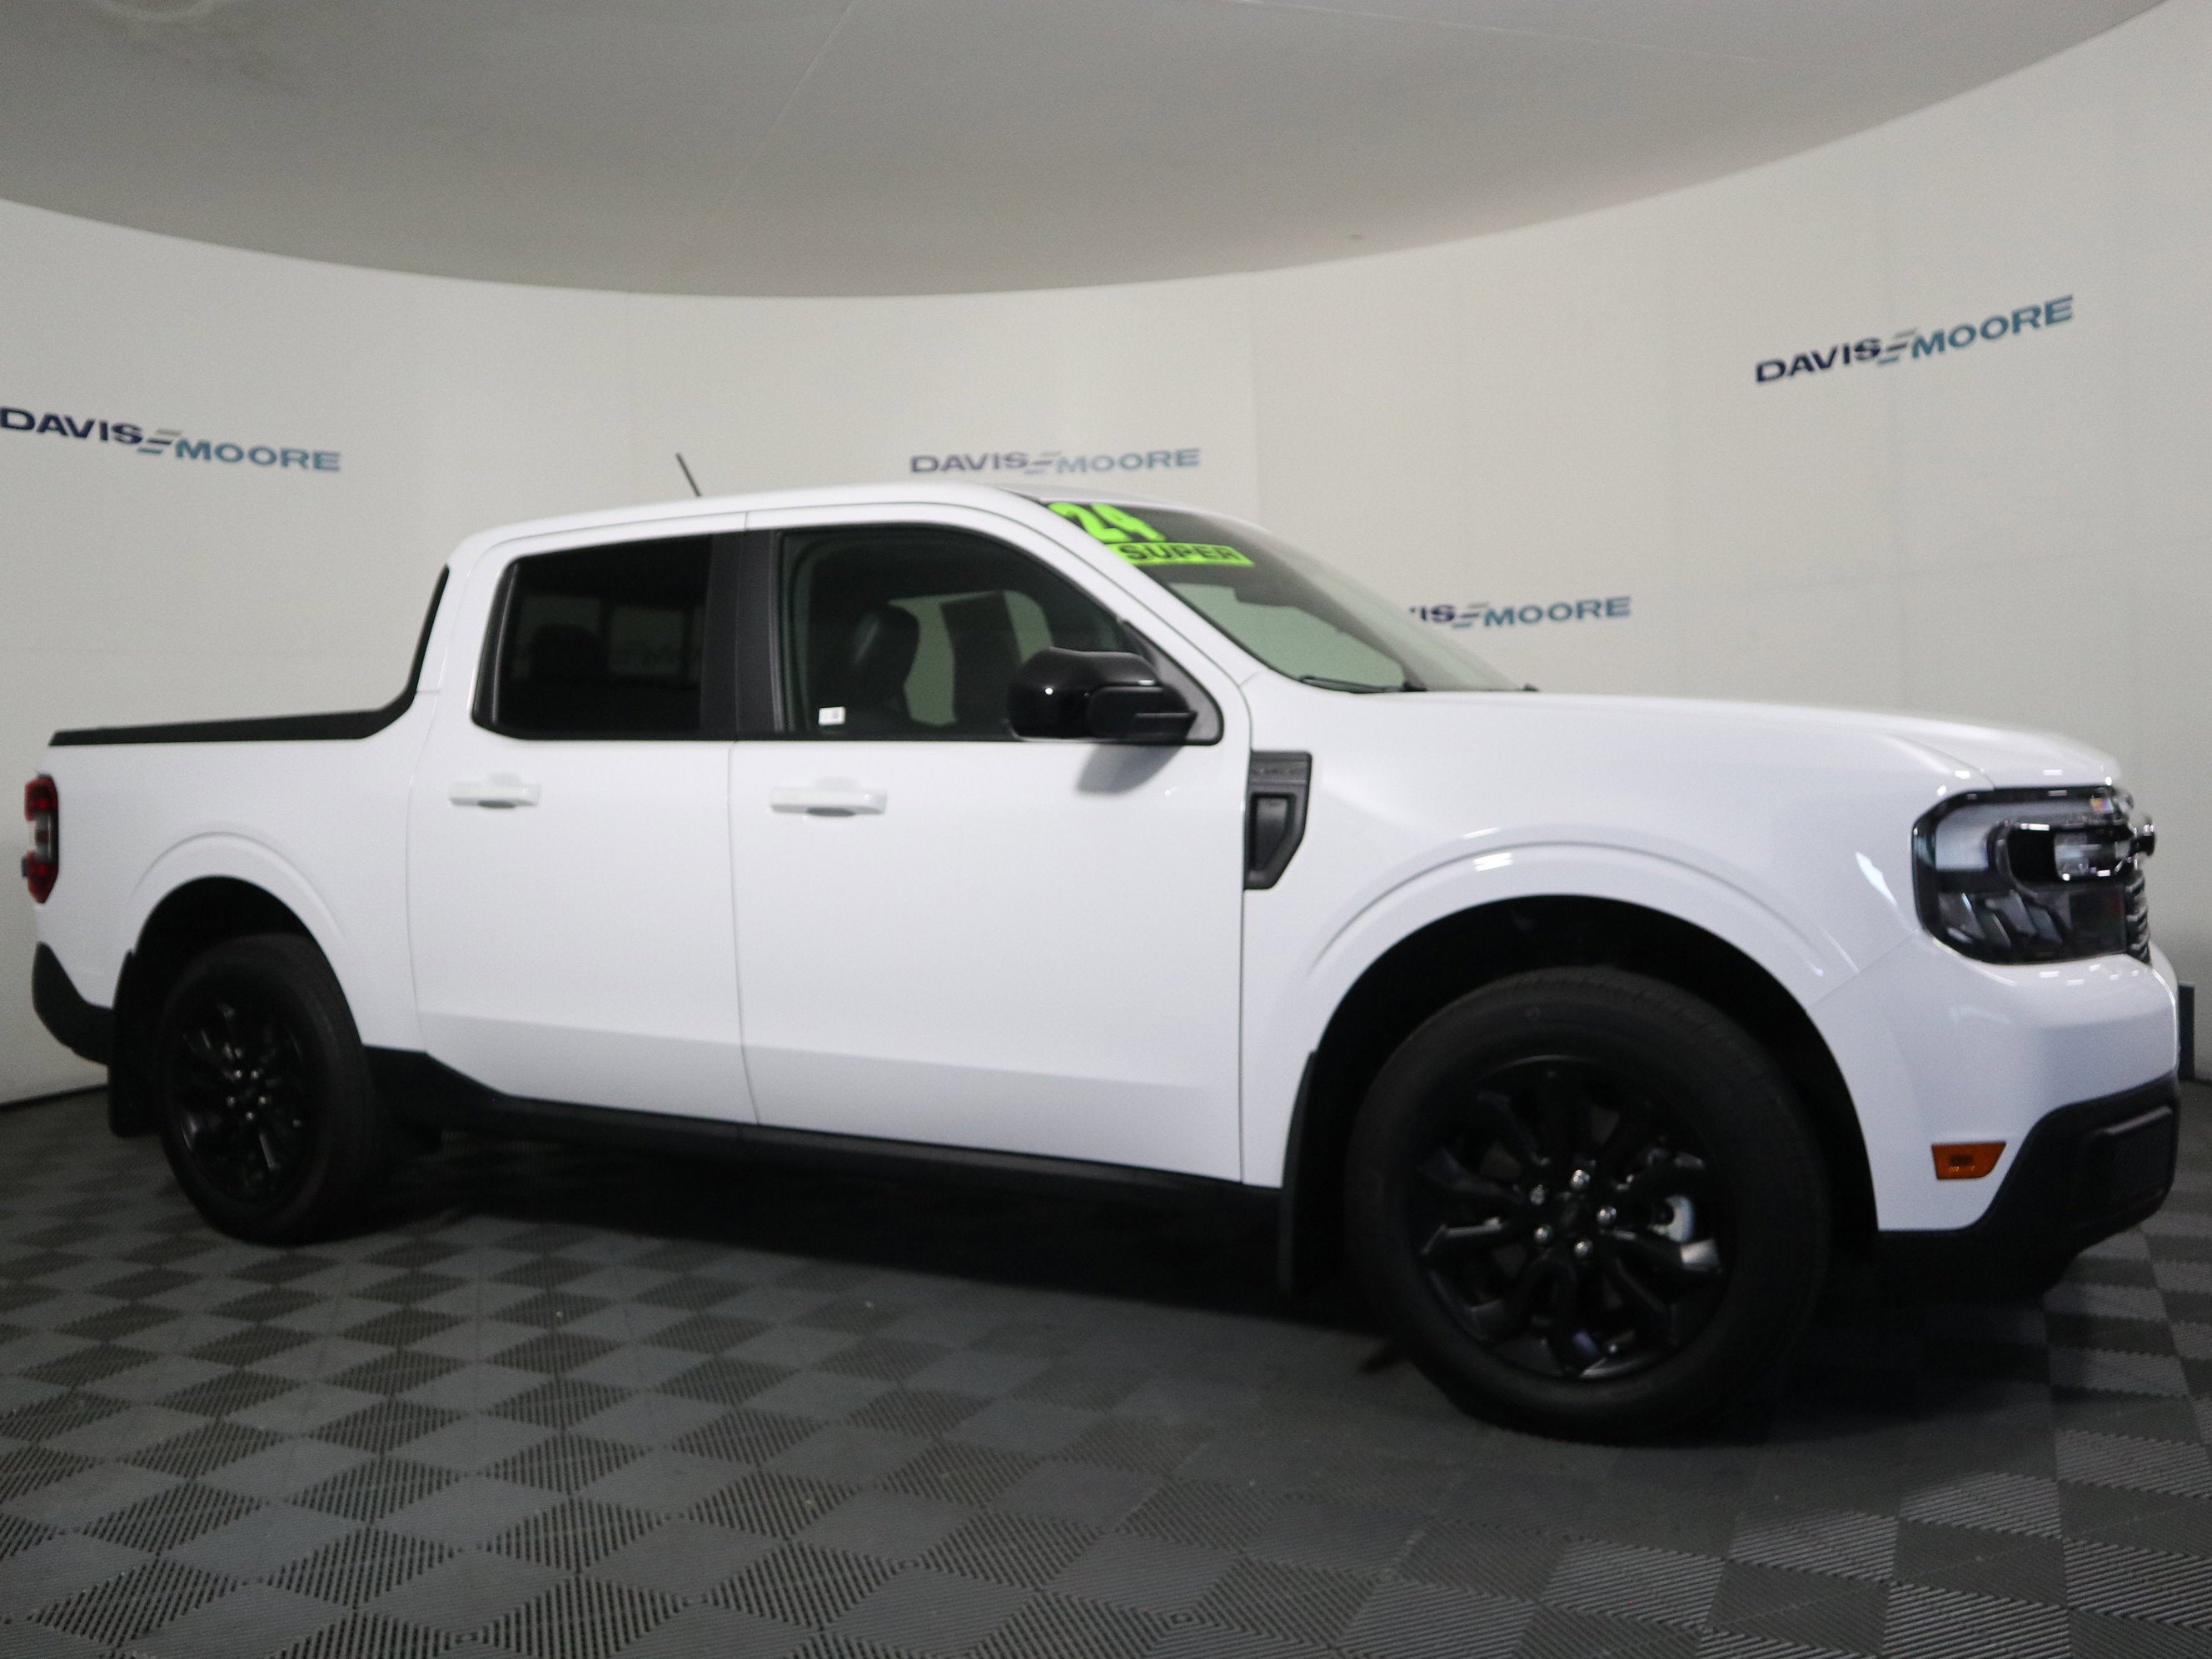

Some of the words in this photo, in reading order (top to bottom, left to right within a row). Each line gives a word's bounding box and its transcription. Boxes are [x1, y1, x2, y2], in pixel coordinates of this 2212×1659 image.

[1755, 337, 1881, 383] DAVIS
[1911, 294, 2075, 359] MOORE
[0, 406, 143, 445] DAVIS
[175, 437, 341, 472] MOORE
[909, 451, 1030, 474] DAVIS
[1056, 448, 1200, 474] MOORE
[1047, 501, 1165, 541] 24
[1118, 543, 1242, 560] SUPER
[1483, 595, 1632, 626] MOORE
